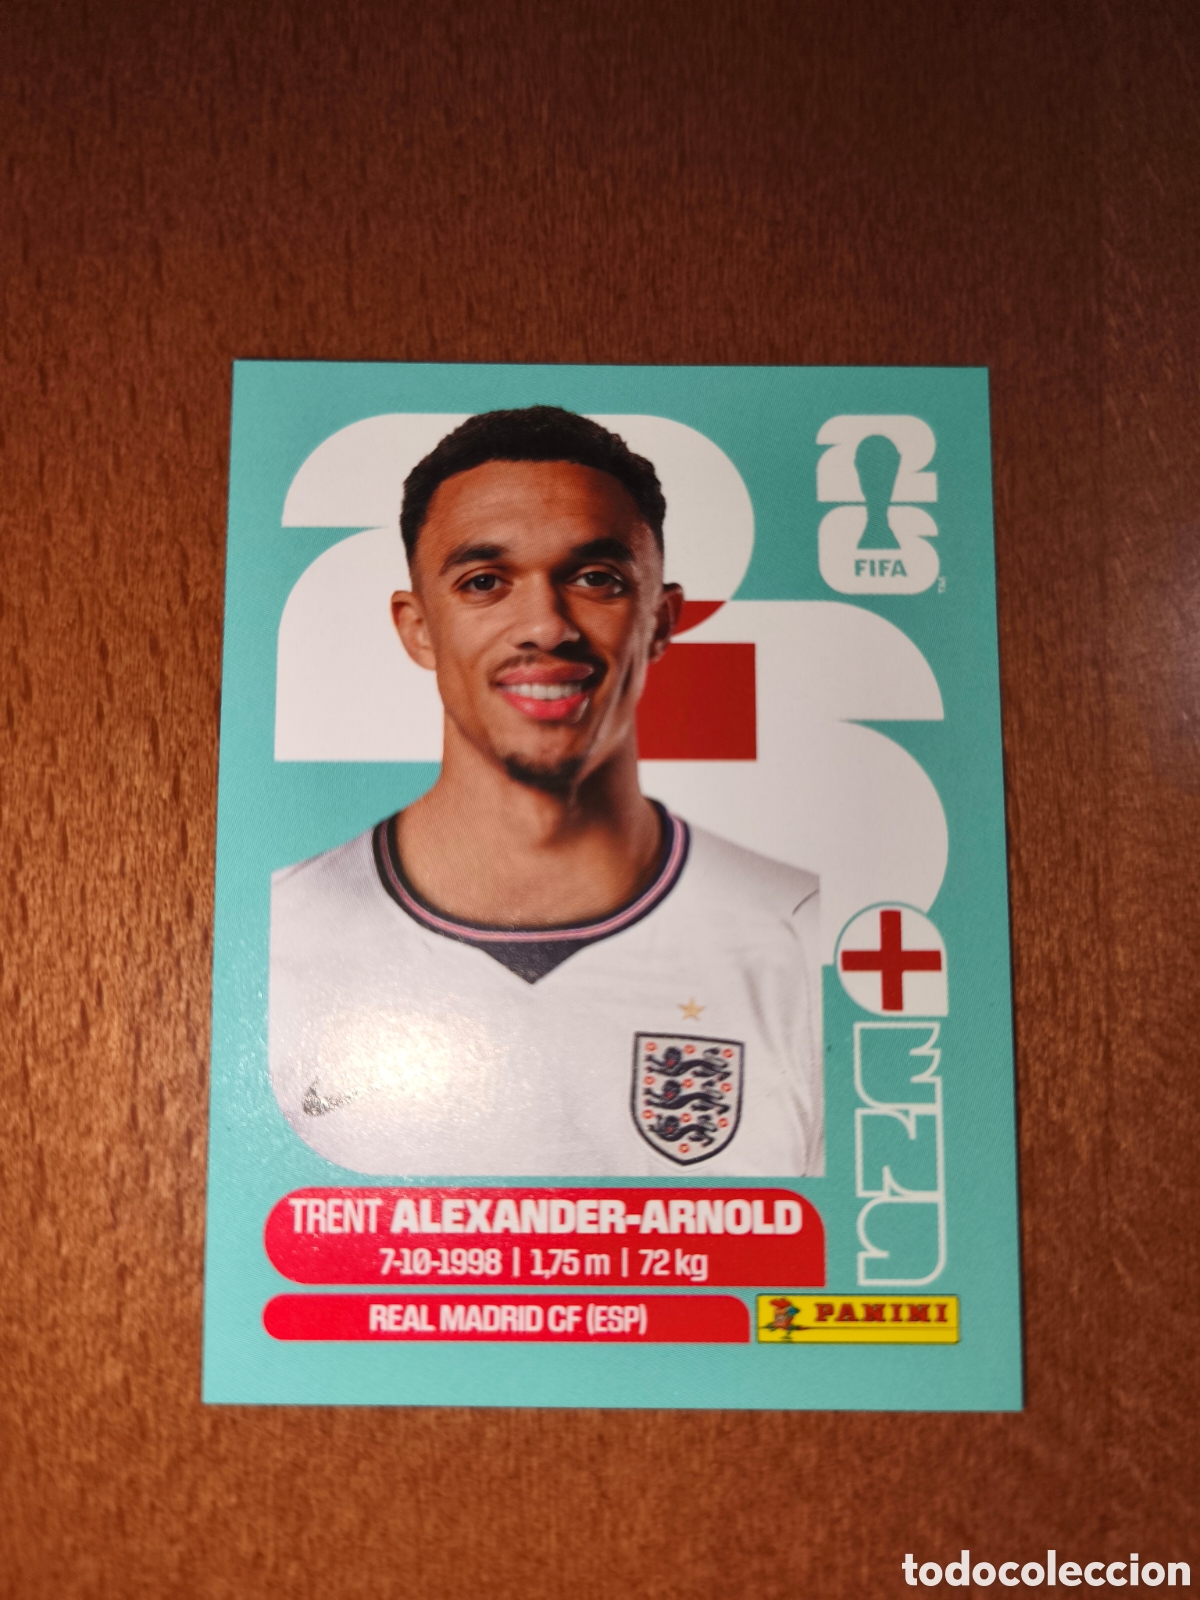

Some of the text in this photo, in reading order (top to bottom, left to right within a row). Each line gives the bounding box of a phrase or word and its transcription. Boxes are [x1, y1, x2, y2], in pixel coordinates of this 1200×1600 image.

[854, 559, 908, 577] FIFA
[289, 1198, 804, 1235] TRENT ALEXANDER-ARNOLD
[379, 1247, 502, 1276] 7-10-1998
[530, 1248, 580, 1279] 1,75
[584, 1253, 610, 1276] m
[638, 1248, 670, 1276] 72
[675, 1248, 708, 1282] kg
[369, 1303, 648, 1335] REAL MADRID CF (ESP)
[814, 1303, 948, 1323] PANINI
